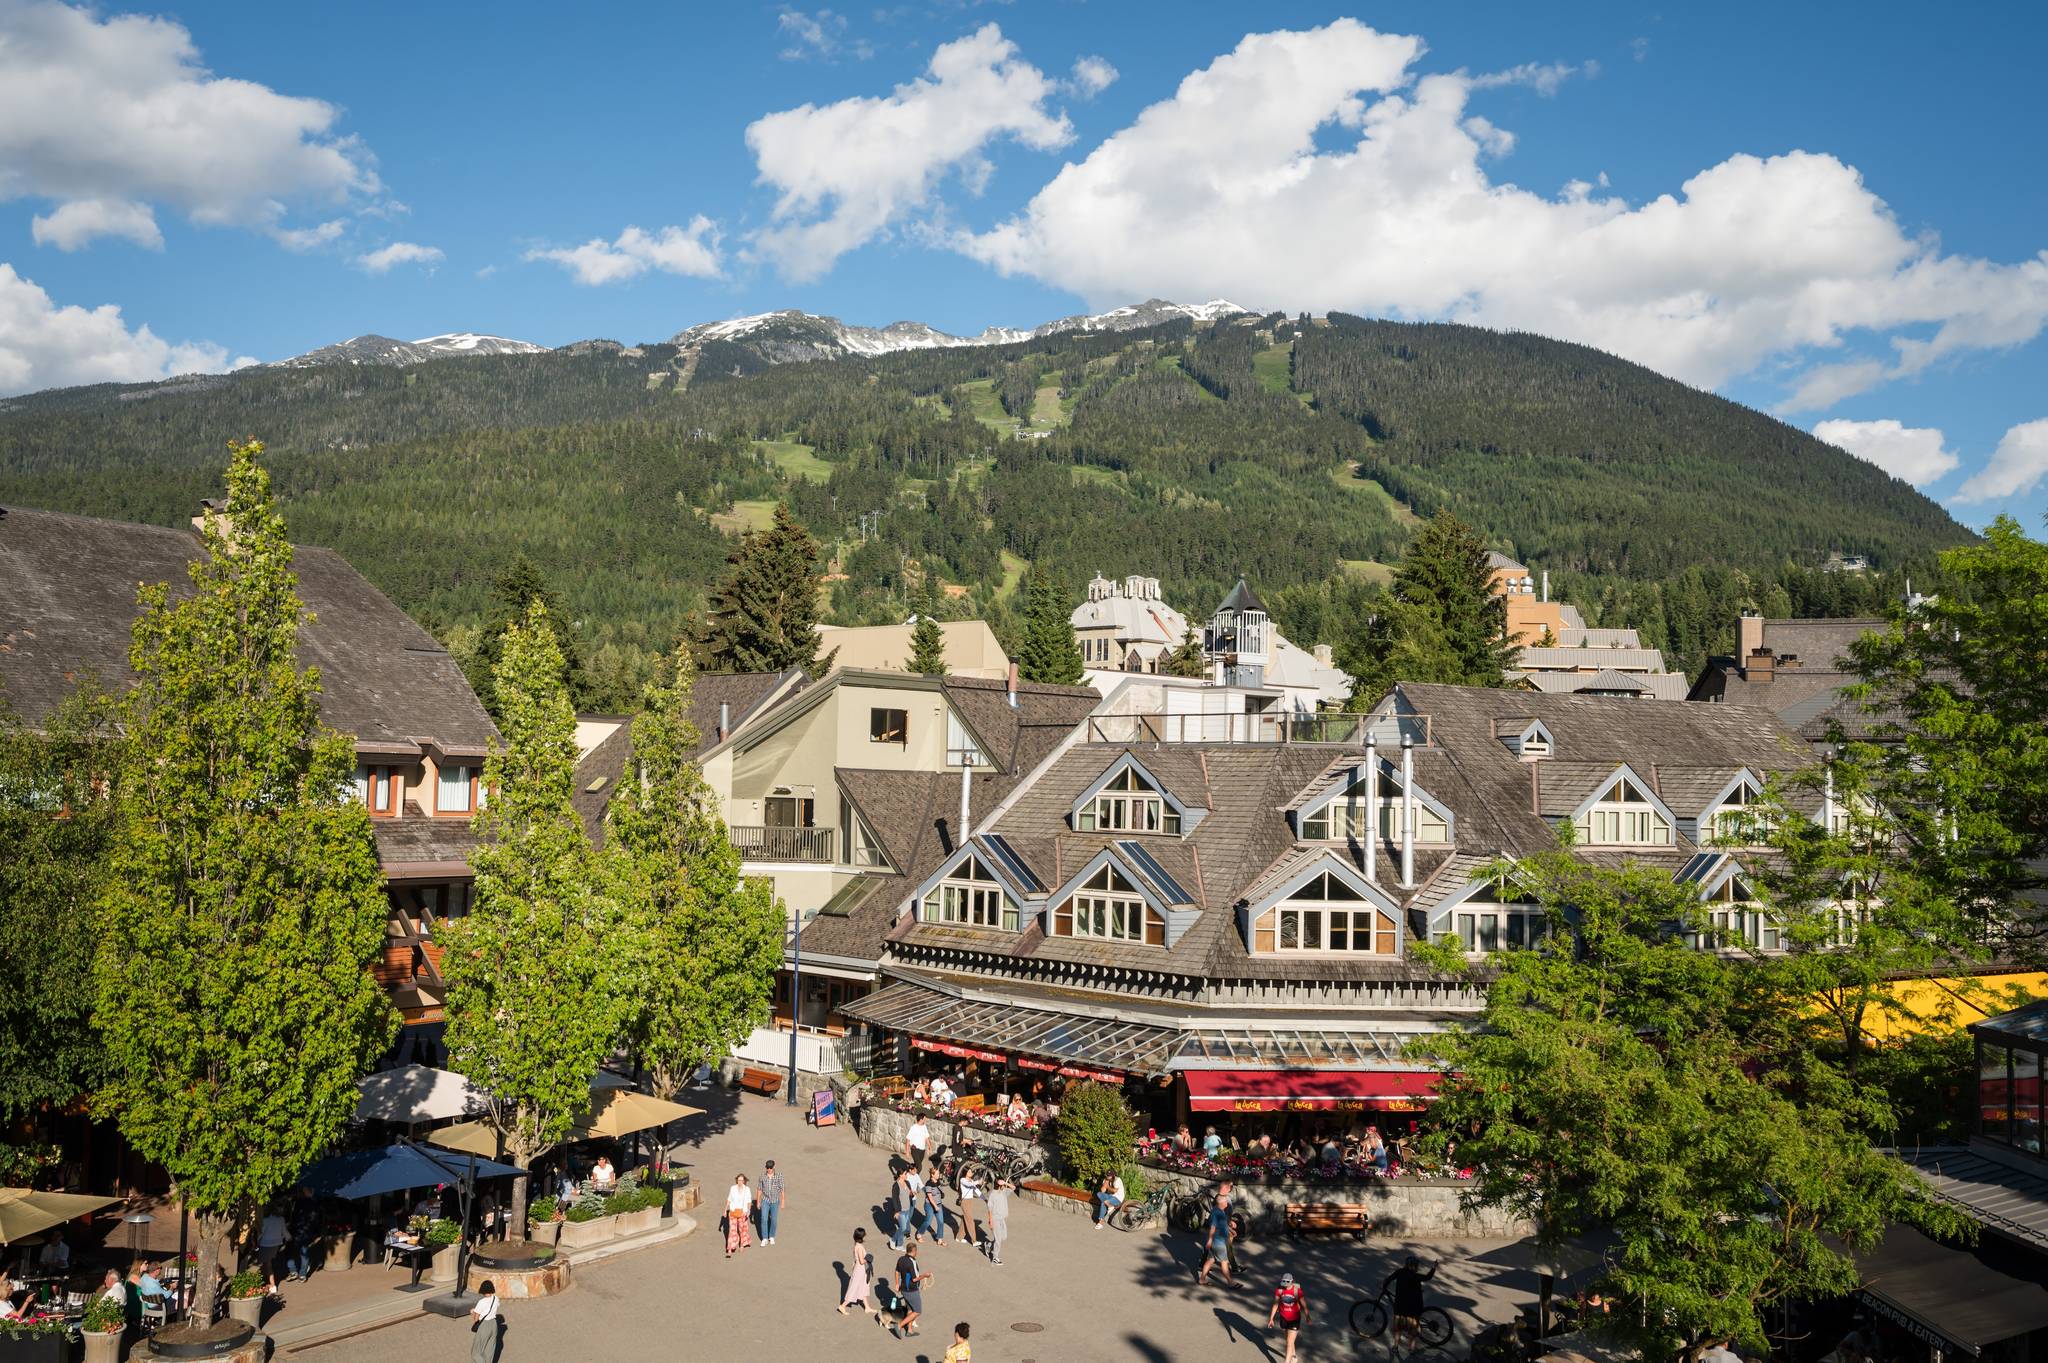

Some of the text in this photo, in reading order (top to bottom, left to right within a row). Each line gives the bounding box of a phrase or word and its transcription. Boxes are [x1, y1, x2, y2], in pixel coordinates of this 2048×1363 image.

[1862, 1293, 1947, 1351] BEACON PUB & EATERY
